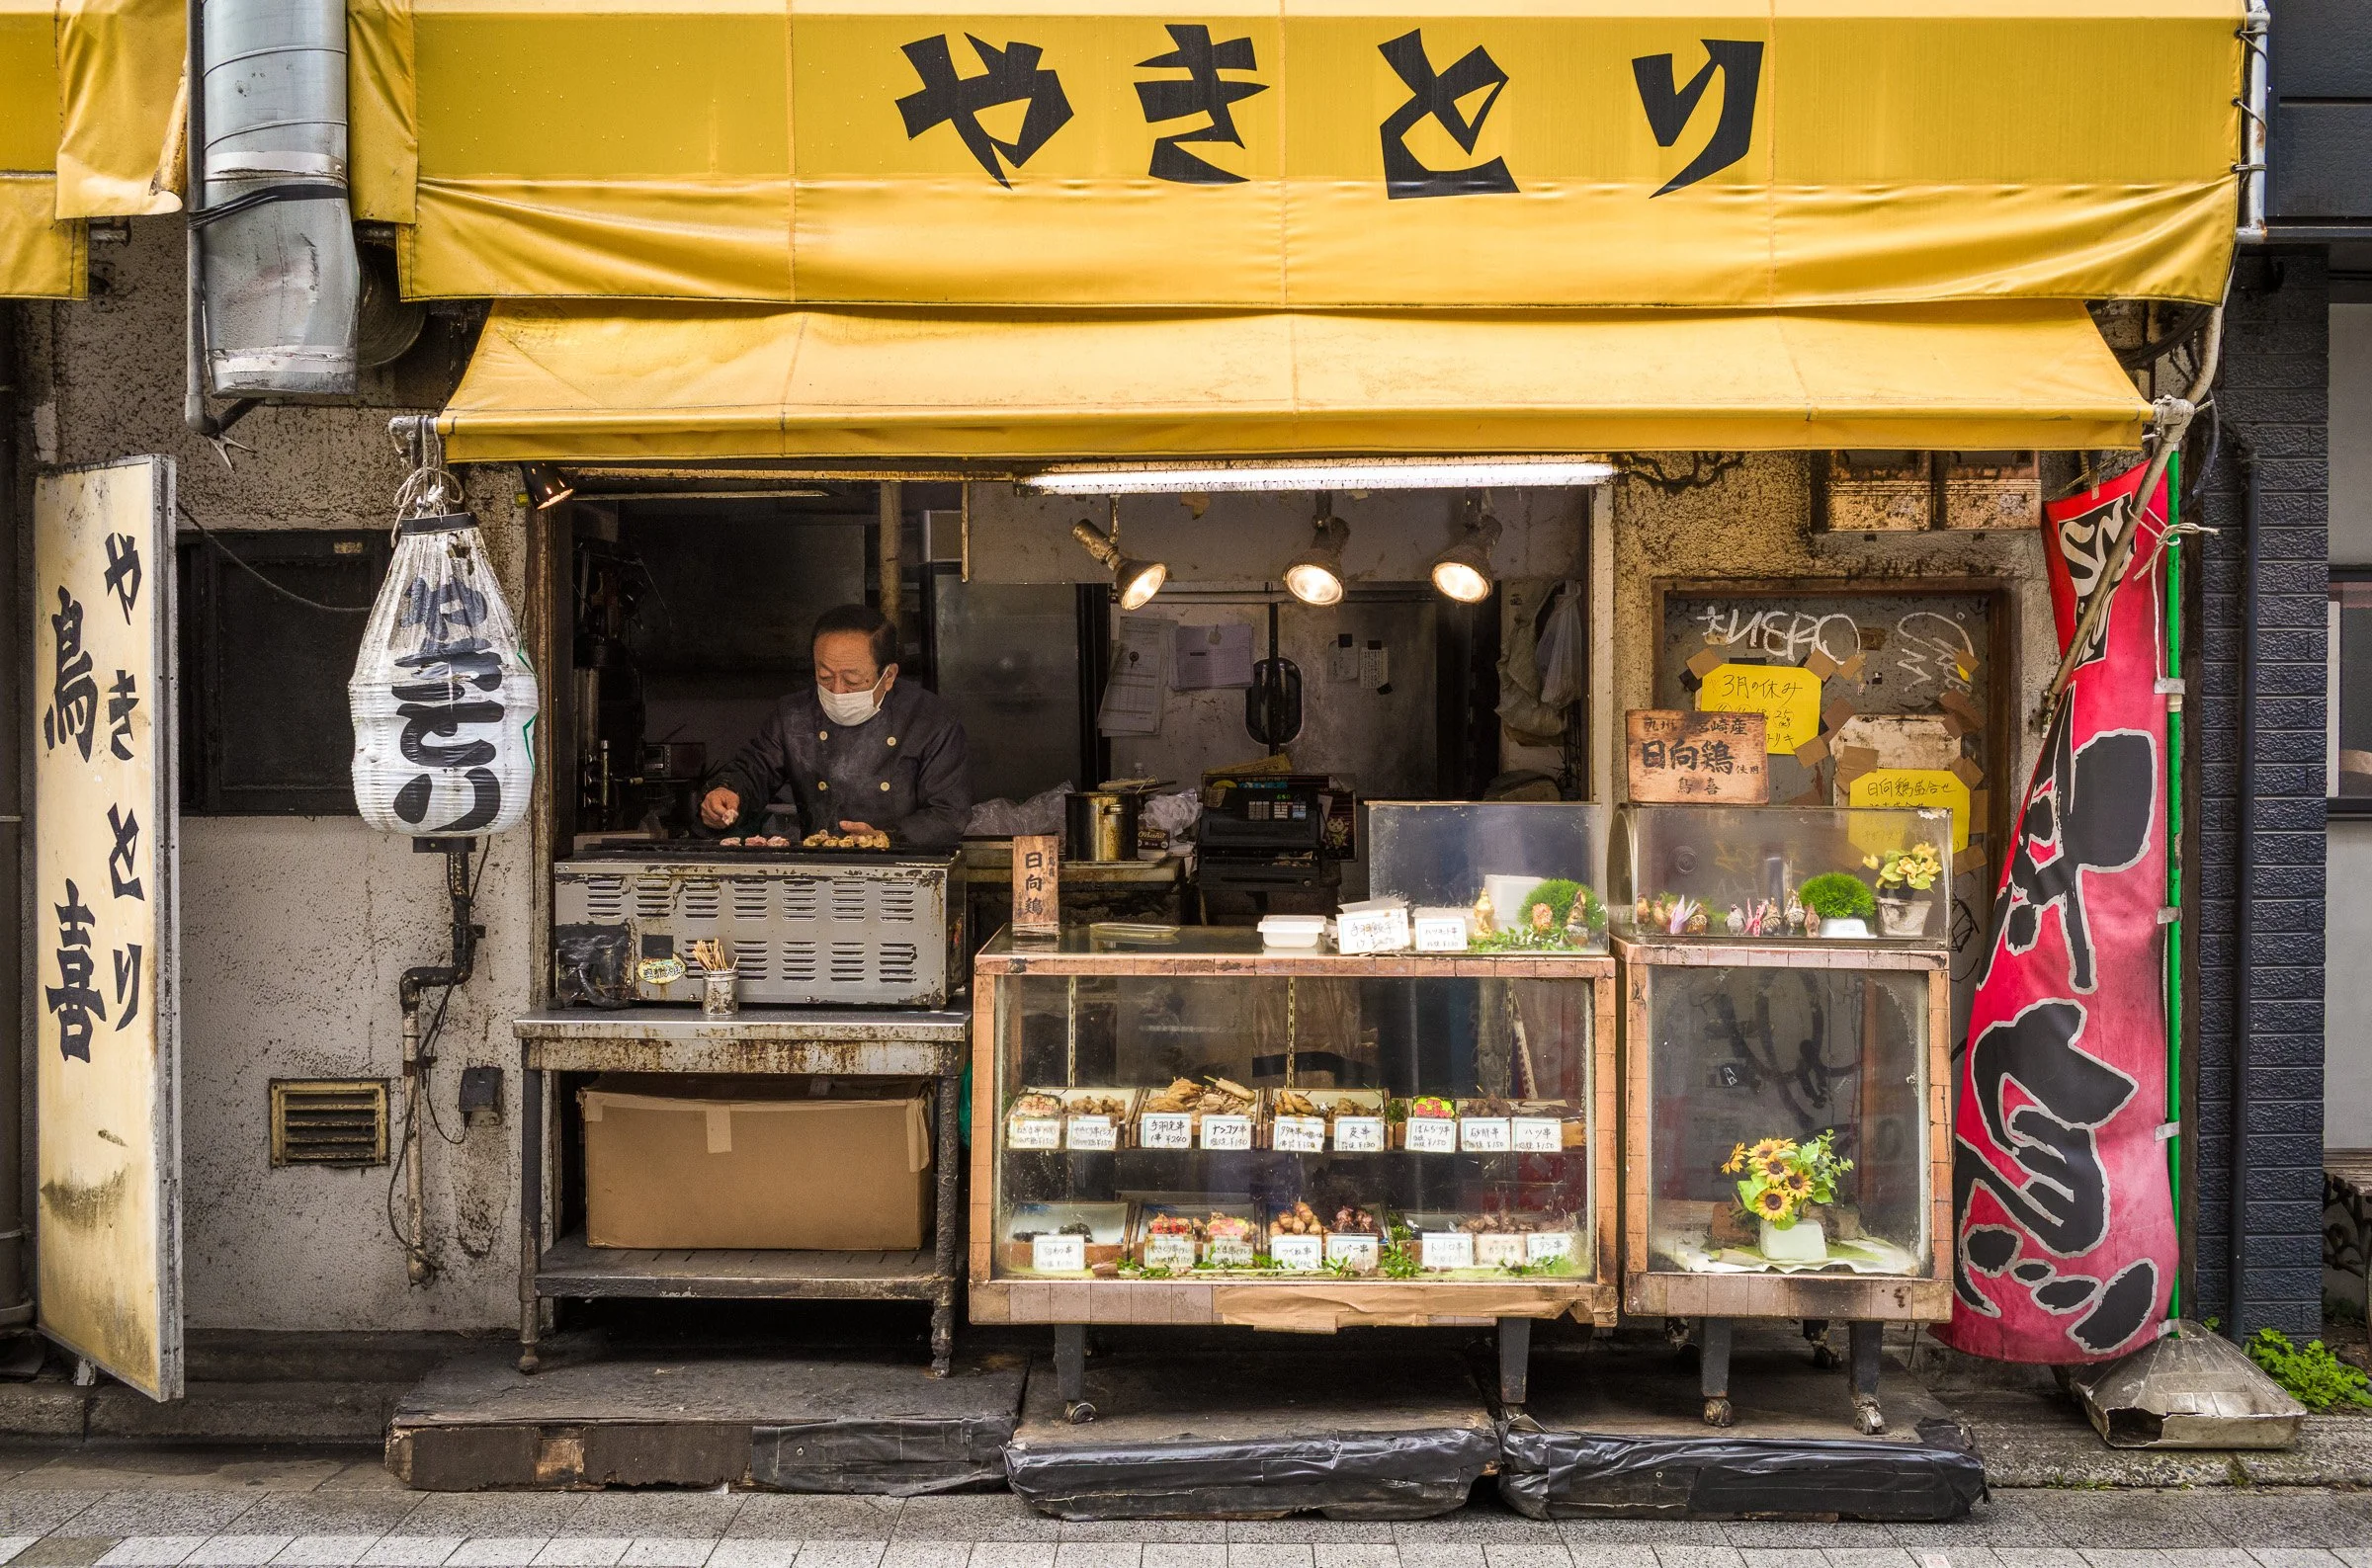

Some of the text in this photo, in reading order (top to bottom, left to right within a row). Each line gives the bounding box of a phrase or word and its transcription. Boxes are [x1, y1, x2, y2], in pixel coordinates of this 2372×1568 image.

[894, 24, 1764, 199] やきとり
[43, 585, 107, 1063] 鳥喜
[103, 532, 145, 1031] やきとり
